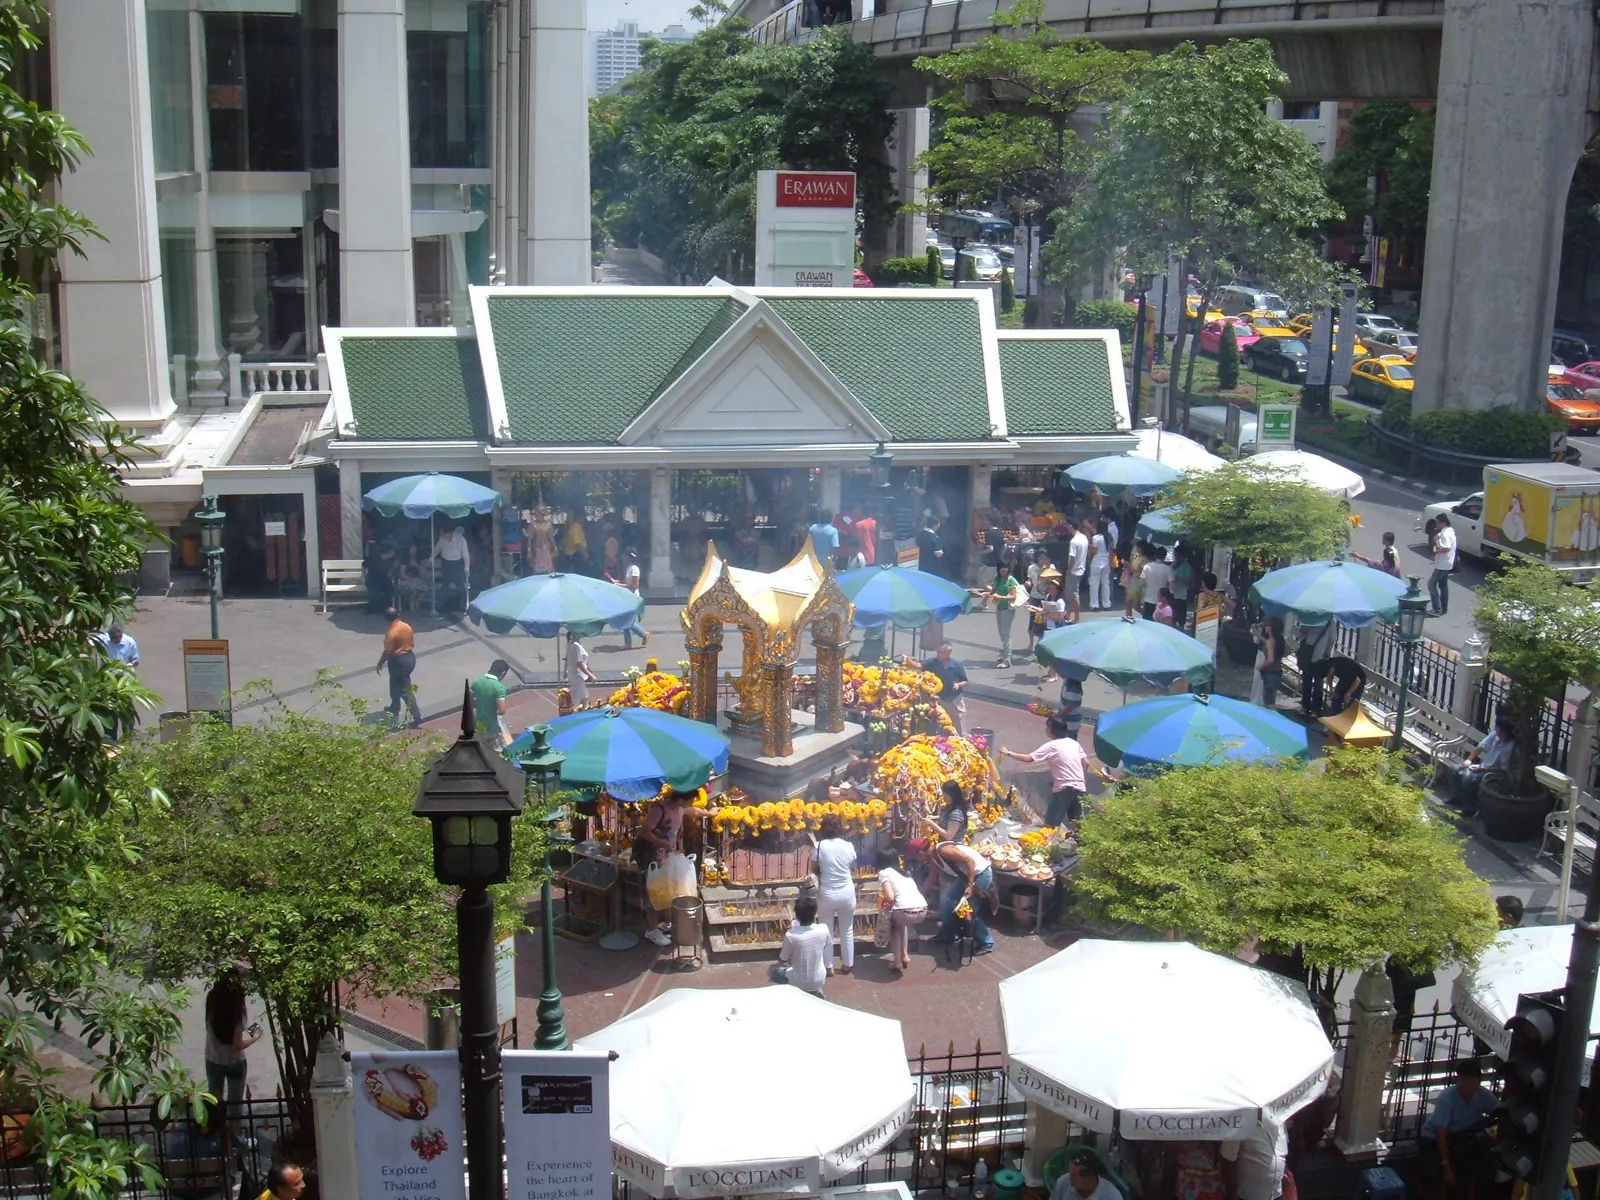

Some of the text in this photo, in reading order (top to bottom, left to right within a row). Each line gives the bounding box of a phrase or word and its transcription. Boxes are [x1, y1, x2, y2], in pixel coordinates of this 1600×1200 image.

[784, 179, 848, 195] ERAWAN
[795, 271, 833, 280] ERAWAN
[381, 1164, 428, 1176] Explore
[526, 1160, 592, 1172] Experience
[526, 1172, 595, 1185] the heart of
[688, 1165, 807, 1188] L'OCCITANE
[383, 1179, 437, 1191] Thailand
[527, 1188, 594, 1200] Bangkok at
